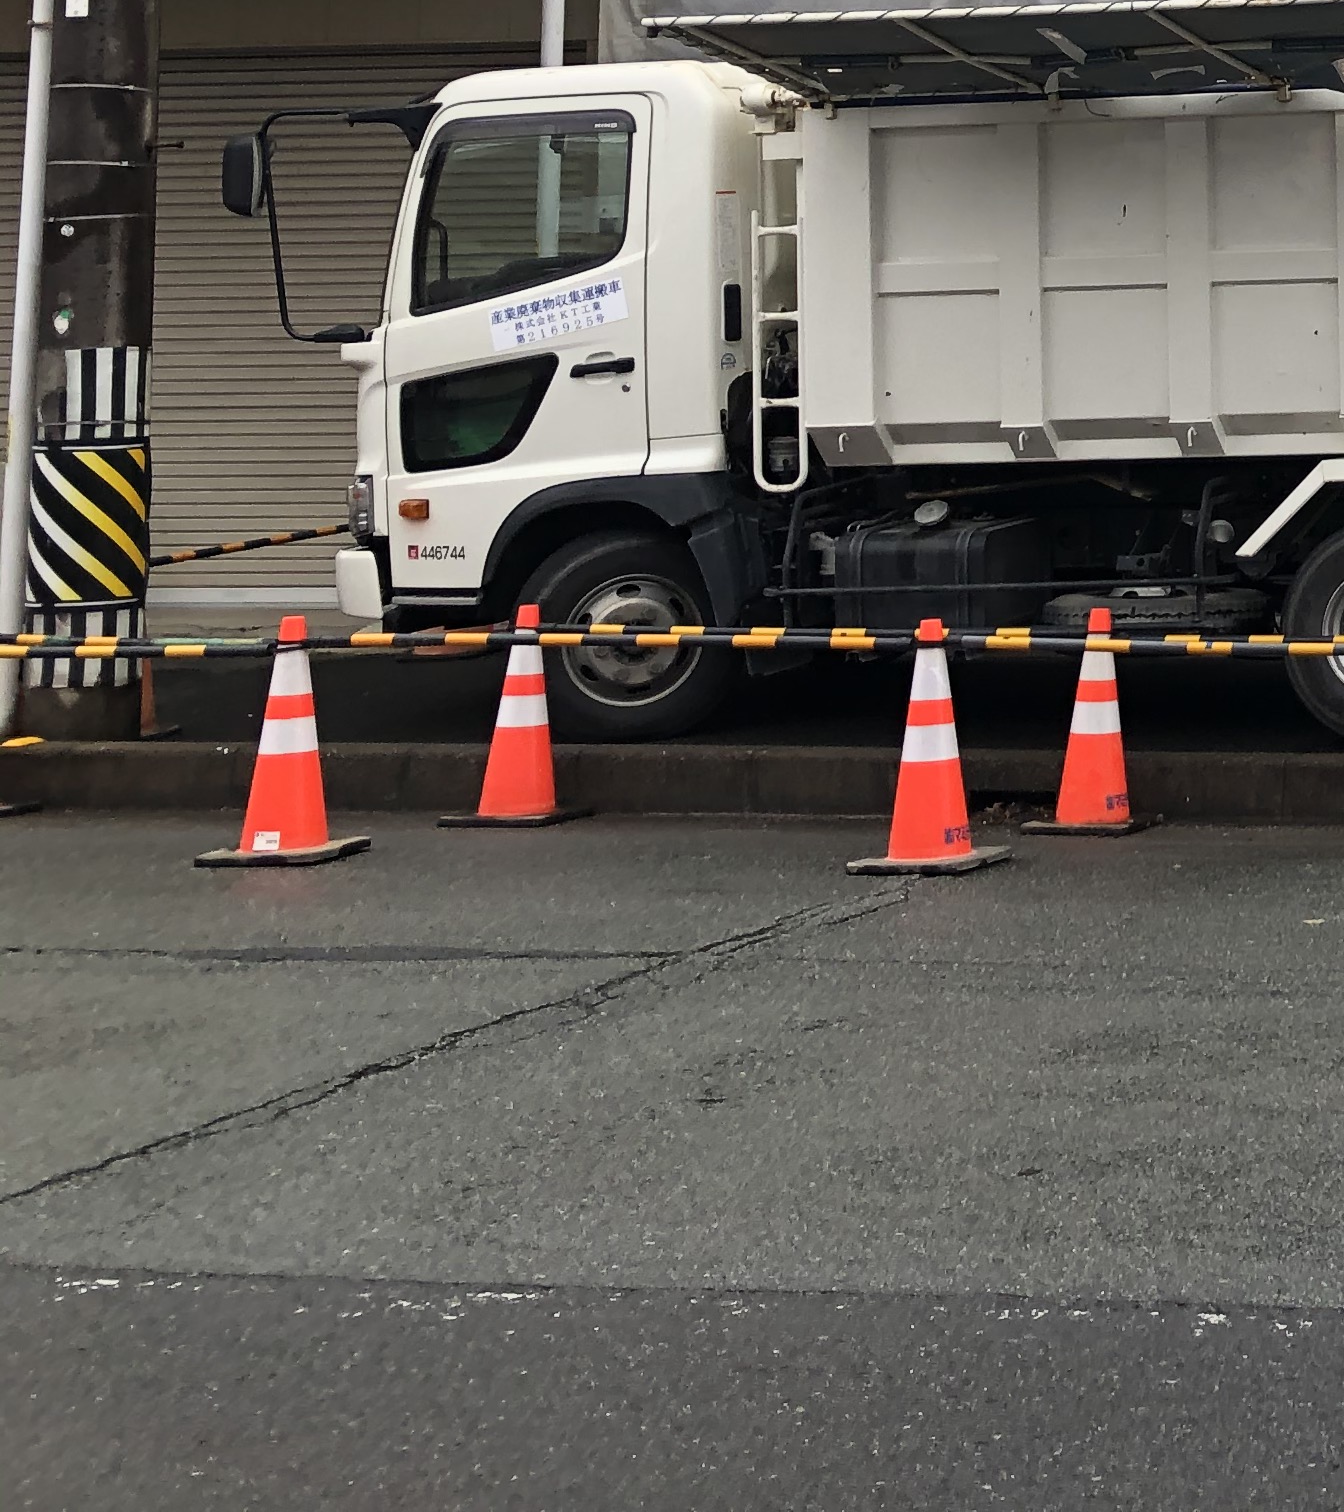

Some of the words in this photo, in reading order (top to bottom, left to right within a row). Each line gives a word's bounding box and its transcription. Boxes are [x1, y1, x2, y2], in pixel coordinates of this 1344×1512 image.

[491, 279, 622, 325] 産業廃棄物収集運搬車
[420, 545, 466, 560] 446744
